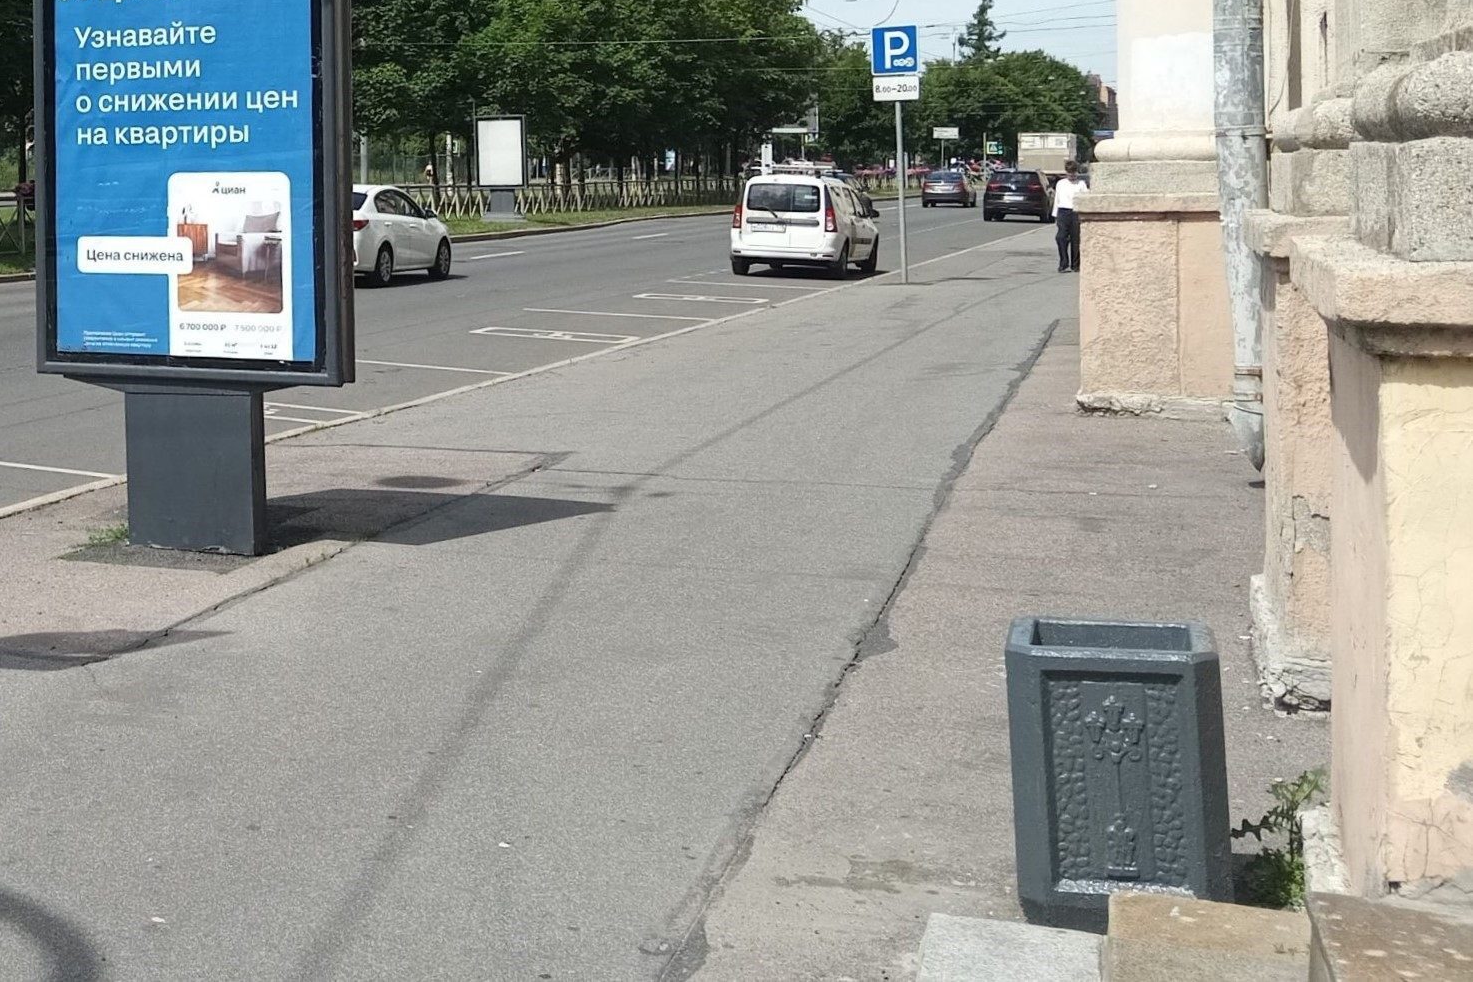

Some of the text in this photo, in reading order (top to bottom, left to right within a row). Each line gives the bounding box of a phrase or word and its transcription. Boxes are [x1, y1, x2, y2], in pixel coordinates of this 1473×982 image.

[74, 21, 216, 49] Узнавайте
[884, 31, 909, 69] P
[76, 59, 201, 85] первыми
[76, 89, 298, 113] о снижении цен
[77, 124, 249, 149] на квартиры
[221, 186, 246, 196] циан
[86, 249, 184, 262] Цена снижена
[202, 323, 219, 331] 000
